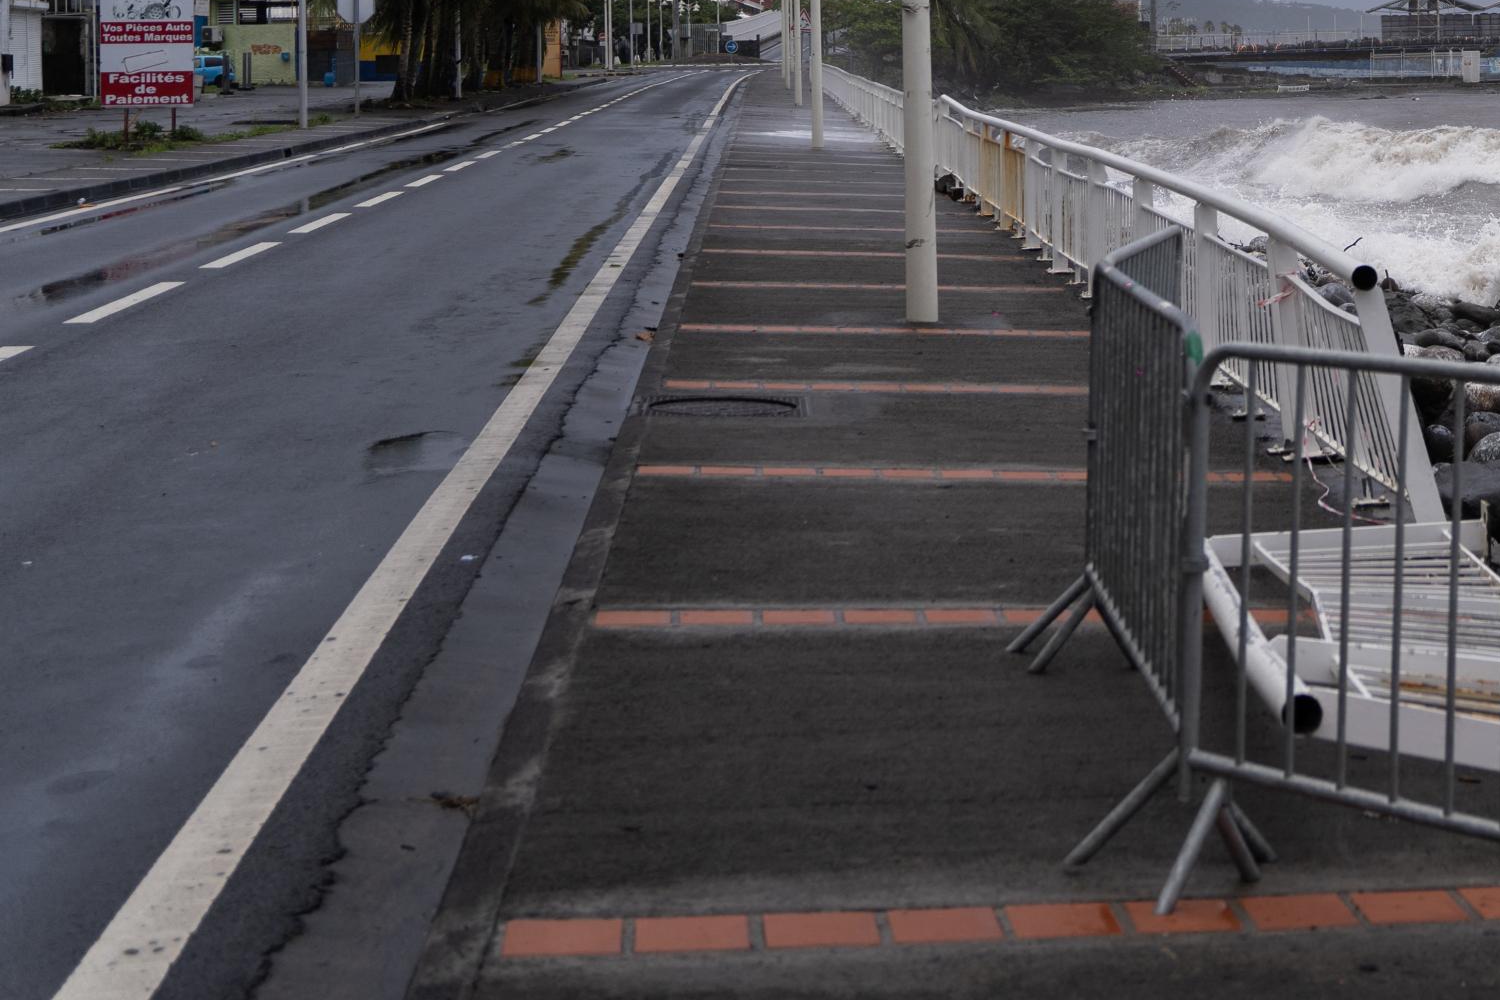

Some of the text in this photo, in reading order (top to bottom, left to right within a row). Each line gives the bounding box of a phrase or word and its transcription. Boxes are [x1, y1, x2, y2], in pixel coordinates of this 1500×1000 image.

[102, 23, 191, 32] Vos Pièces Auto
[102, 33, 193, 43] Toutes Marques
[109, 73, 185, 84] Facilités
[135, 85, 157, 94] de
[105, 94, 189, 105] Paiement
